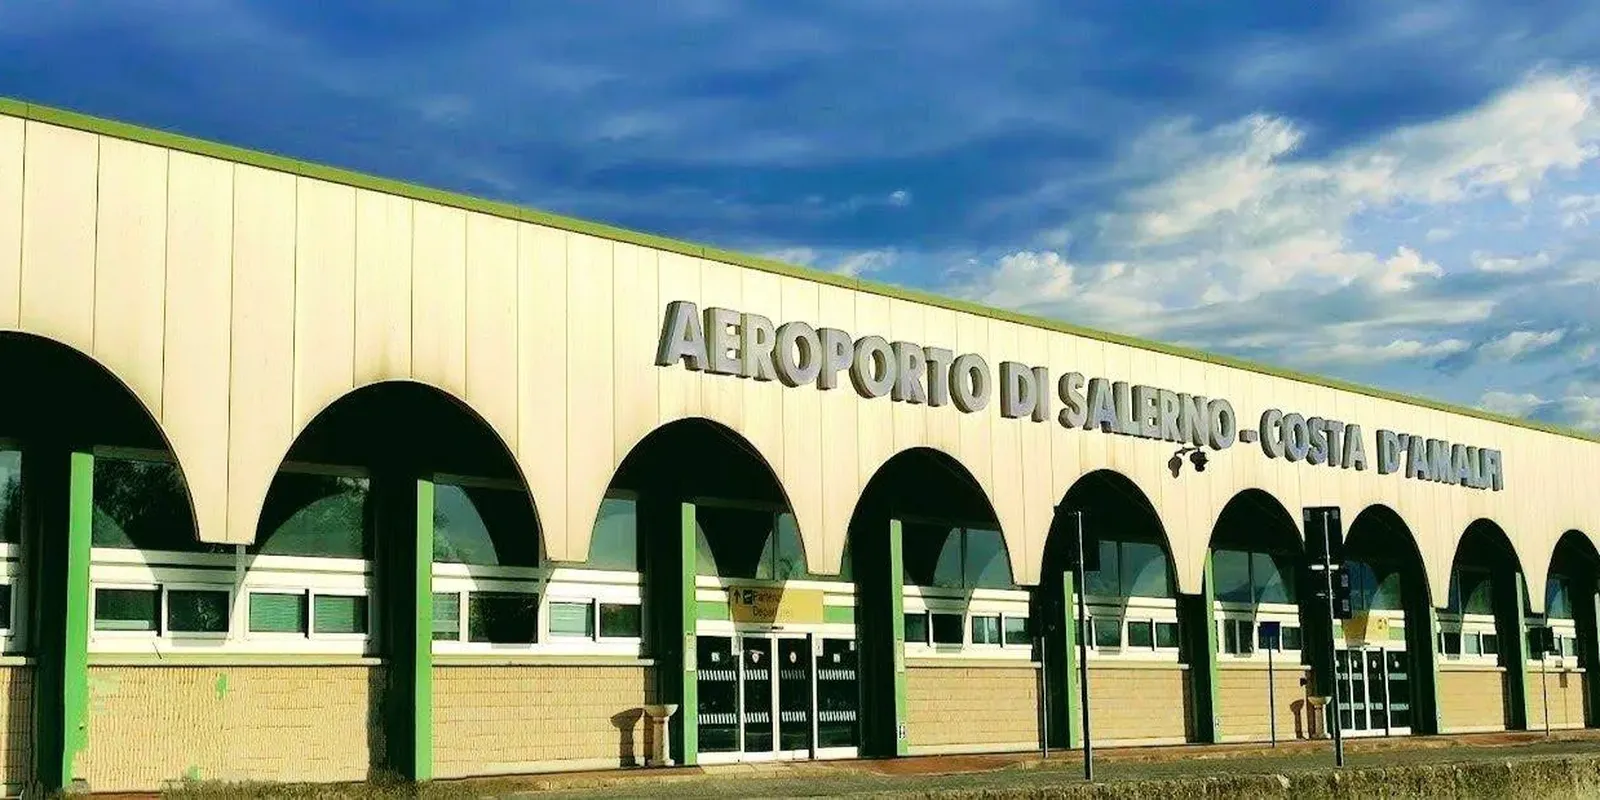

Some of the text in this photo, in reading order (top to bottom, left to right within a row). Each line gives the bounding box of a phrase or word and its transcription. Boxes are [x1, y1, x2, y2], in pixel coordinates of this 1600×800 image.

[656, 301, 991, 413] AEROPORTO
[1001, 361, 1050, 421] DI
[1058, 371, 1235, 449] SALERNO
[1261, 409, 1367, 470] COSTA
[1378, 429, 1504, 491] D'AMALFI
